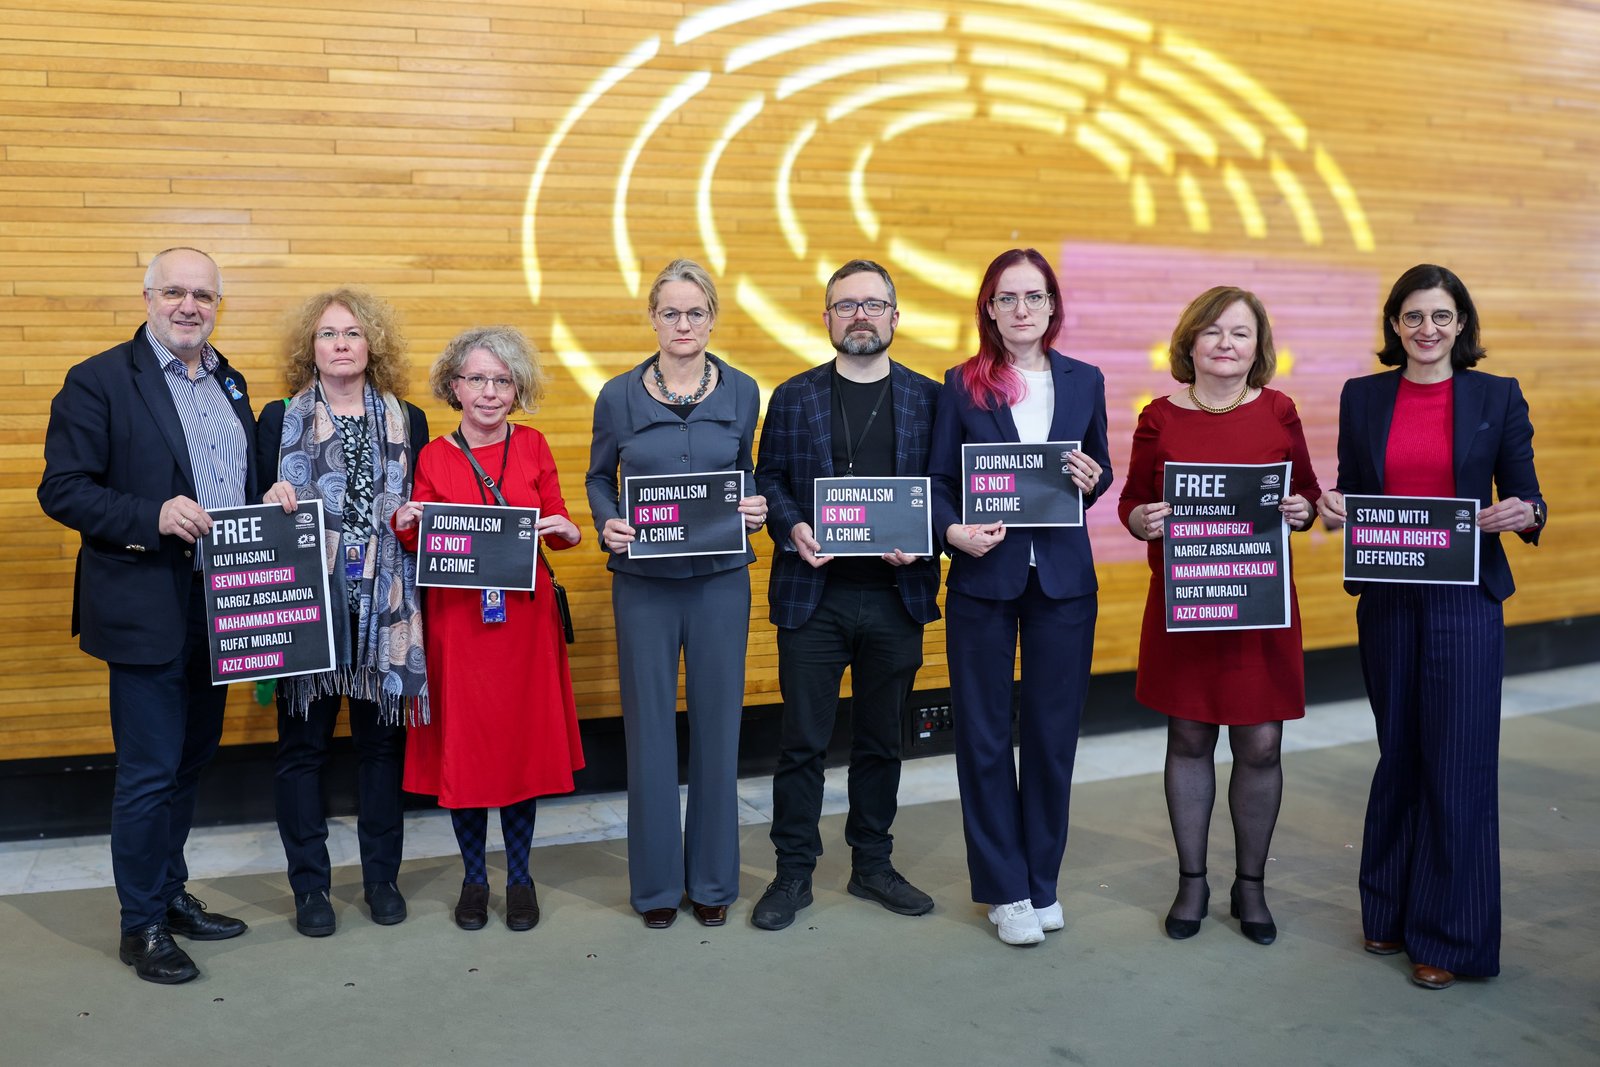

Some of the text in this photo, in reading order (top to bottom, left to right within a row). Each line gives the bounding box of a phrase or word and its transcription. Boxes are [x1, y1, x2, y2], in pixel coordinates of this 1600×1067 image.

[975, 454, 1043, 469] JOURNALISM
[975, 477, 1010, 490] IS NOT
[1175, 474, 1226, 498] FREE
[639, 485, 706, 502] JOURNALISM
[826, 488, 893, 502] JOURNALISM
[975, 497, 1020, 512] A CRIME
[1174, 506, 1235, 516] ULVI HASANLI
[640, 507, 674, 522] IS NOT
[826, 508, 860, 521] IS NOT
[1357, 508, 1428, 524] STAND WITH
[432, 515, 501, 532] JOURNALISM
[1174, 524, 1249, 536] SEVINJ VAGIFGIZI
[212, 517, 263, 546] FREE
[640, 527, 684, 542] A CRIME
[826, 528, 870, 541] A CRIME
[1357, 529, 1446, 546] HUMAN RIGHTS
[431, 536, 466, 551] IS NOT
[1175, 542, 1271, 557] NARGIZ ABSALAMOVA
[213, 550, 275, 566] ULVI HASANLI
[430, 558, 475, 573] A CRIME
[1357, 550, 1425, 566] DEFENDERS
[1176, 563, 1274, 578] MAHAMMAD KEKALOV
[215, 569, 291, 588] SEVINJ VAGIFGIZI
[217, 588, 313, 609] NARGIZ ABSALAMOVA
[1176, 585, 1247, 598] RUFAT MURADLI
[218, 608, 317, 630] MAHAMMAD KEKALOV
[1177, 606, 1233, 619] AZIZ ORUJOV
[220, 632, 292, 651] RUFAT MURADLI
[222, 654, 279, 672] AZIZ ORUJOV
